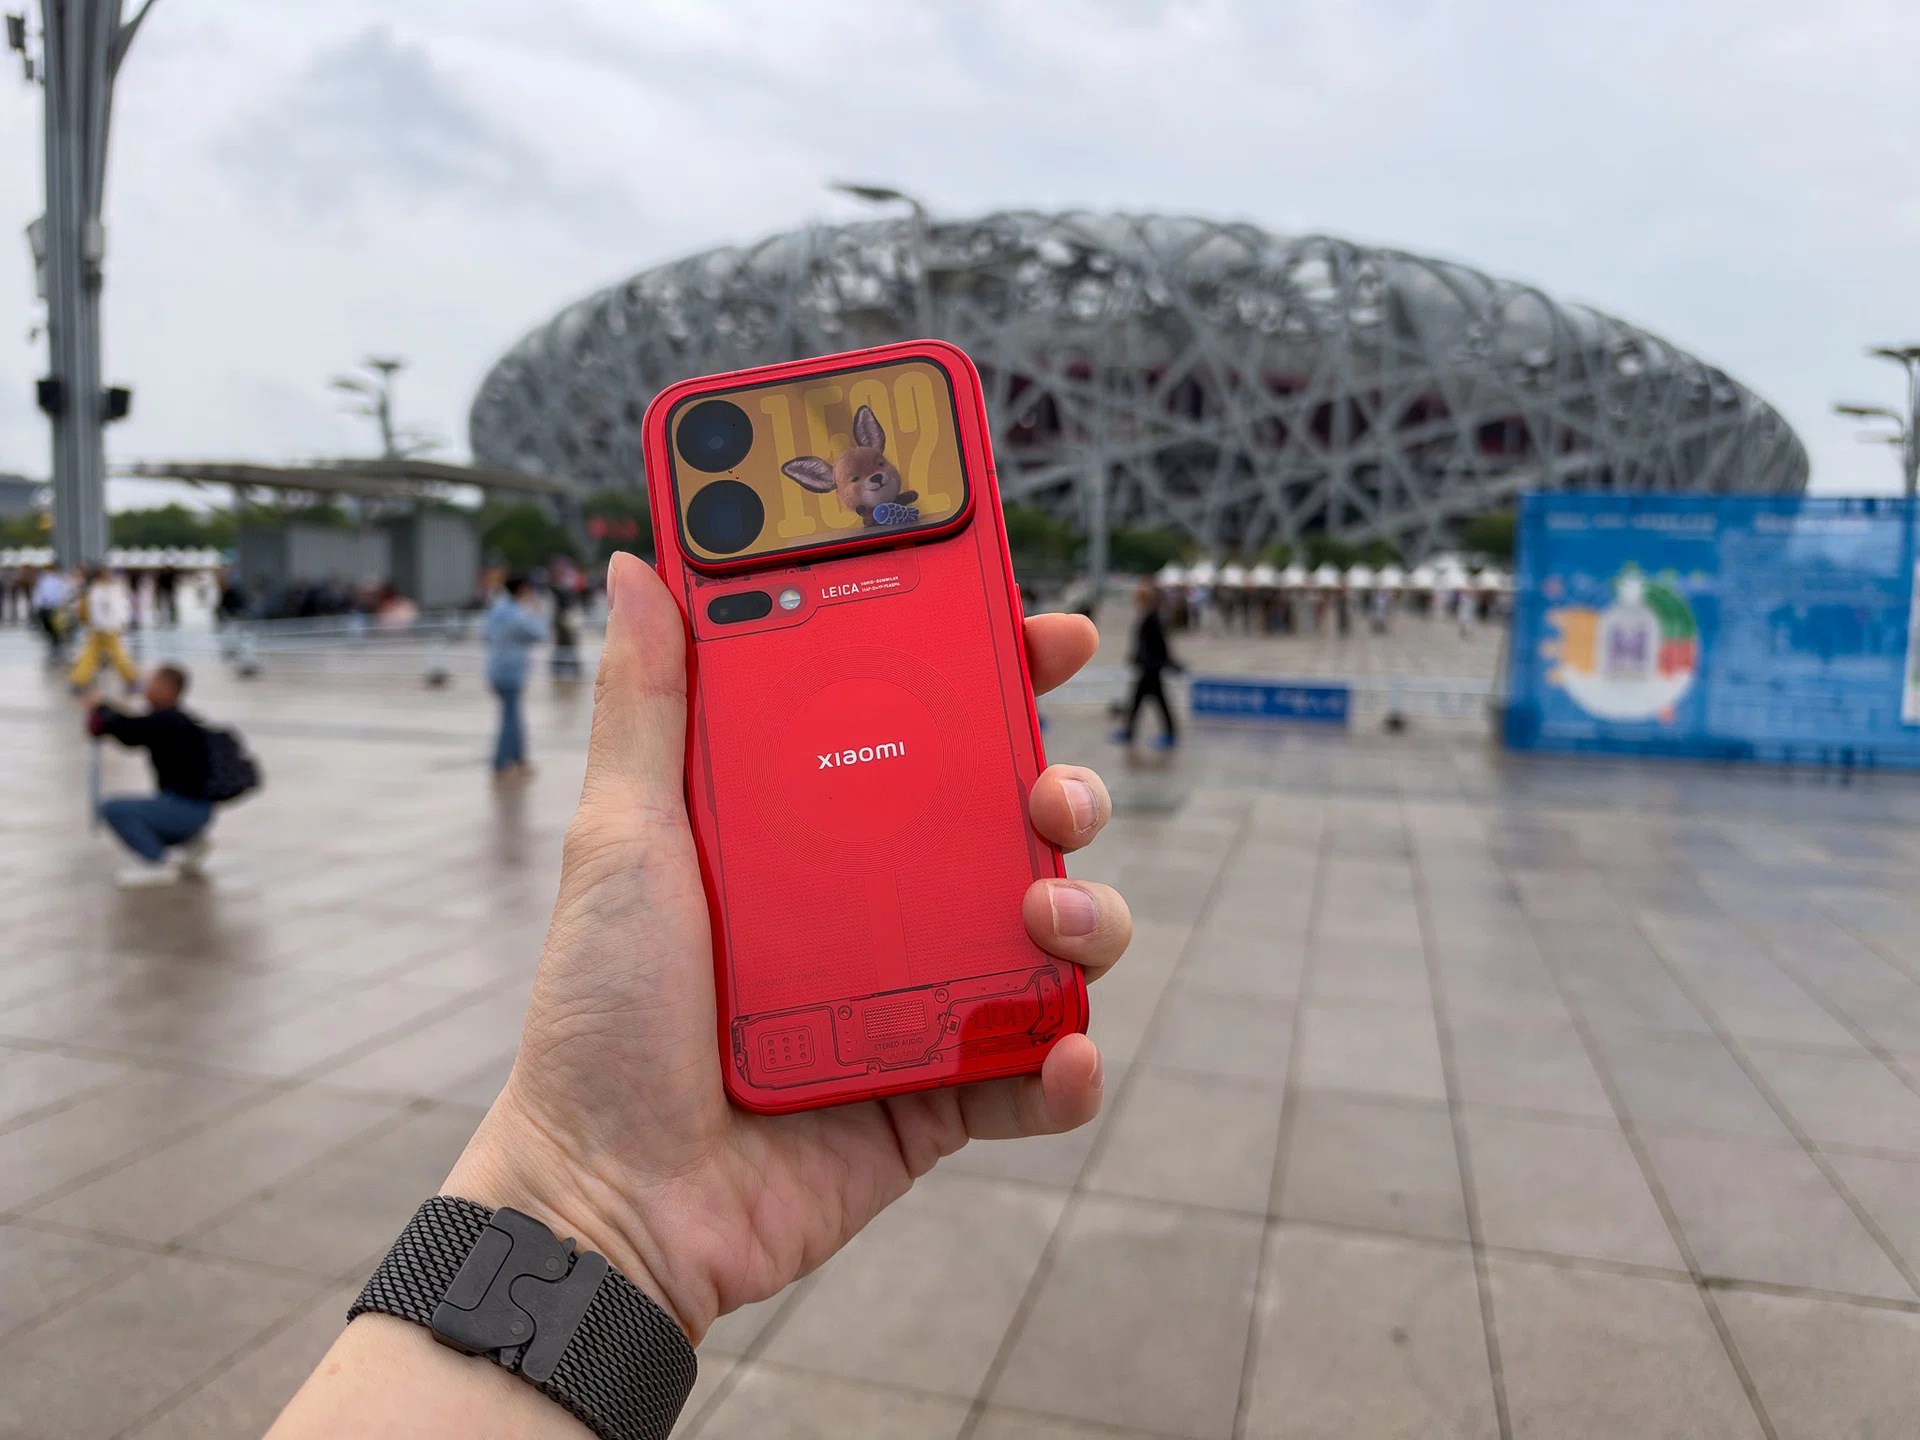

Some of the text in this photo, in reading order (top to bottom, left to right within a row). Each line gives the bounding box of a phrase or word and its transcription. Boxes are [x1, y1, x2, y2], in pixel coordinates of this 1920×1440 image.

[821, 583, 860, 599] LEICA
[817, 741, 905, 770] xiaomi
[874, 1037, 924, 1051] STEREO AUDIO
